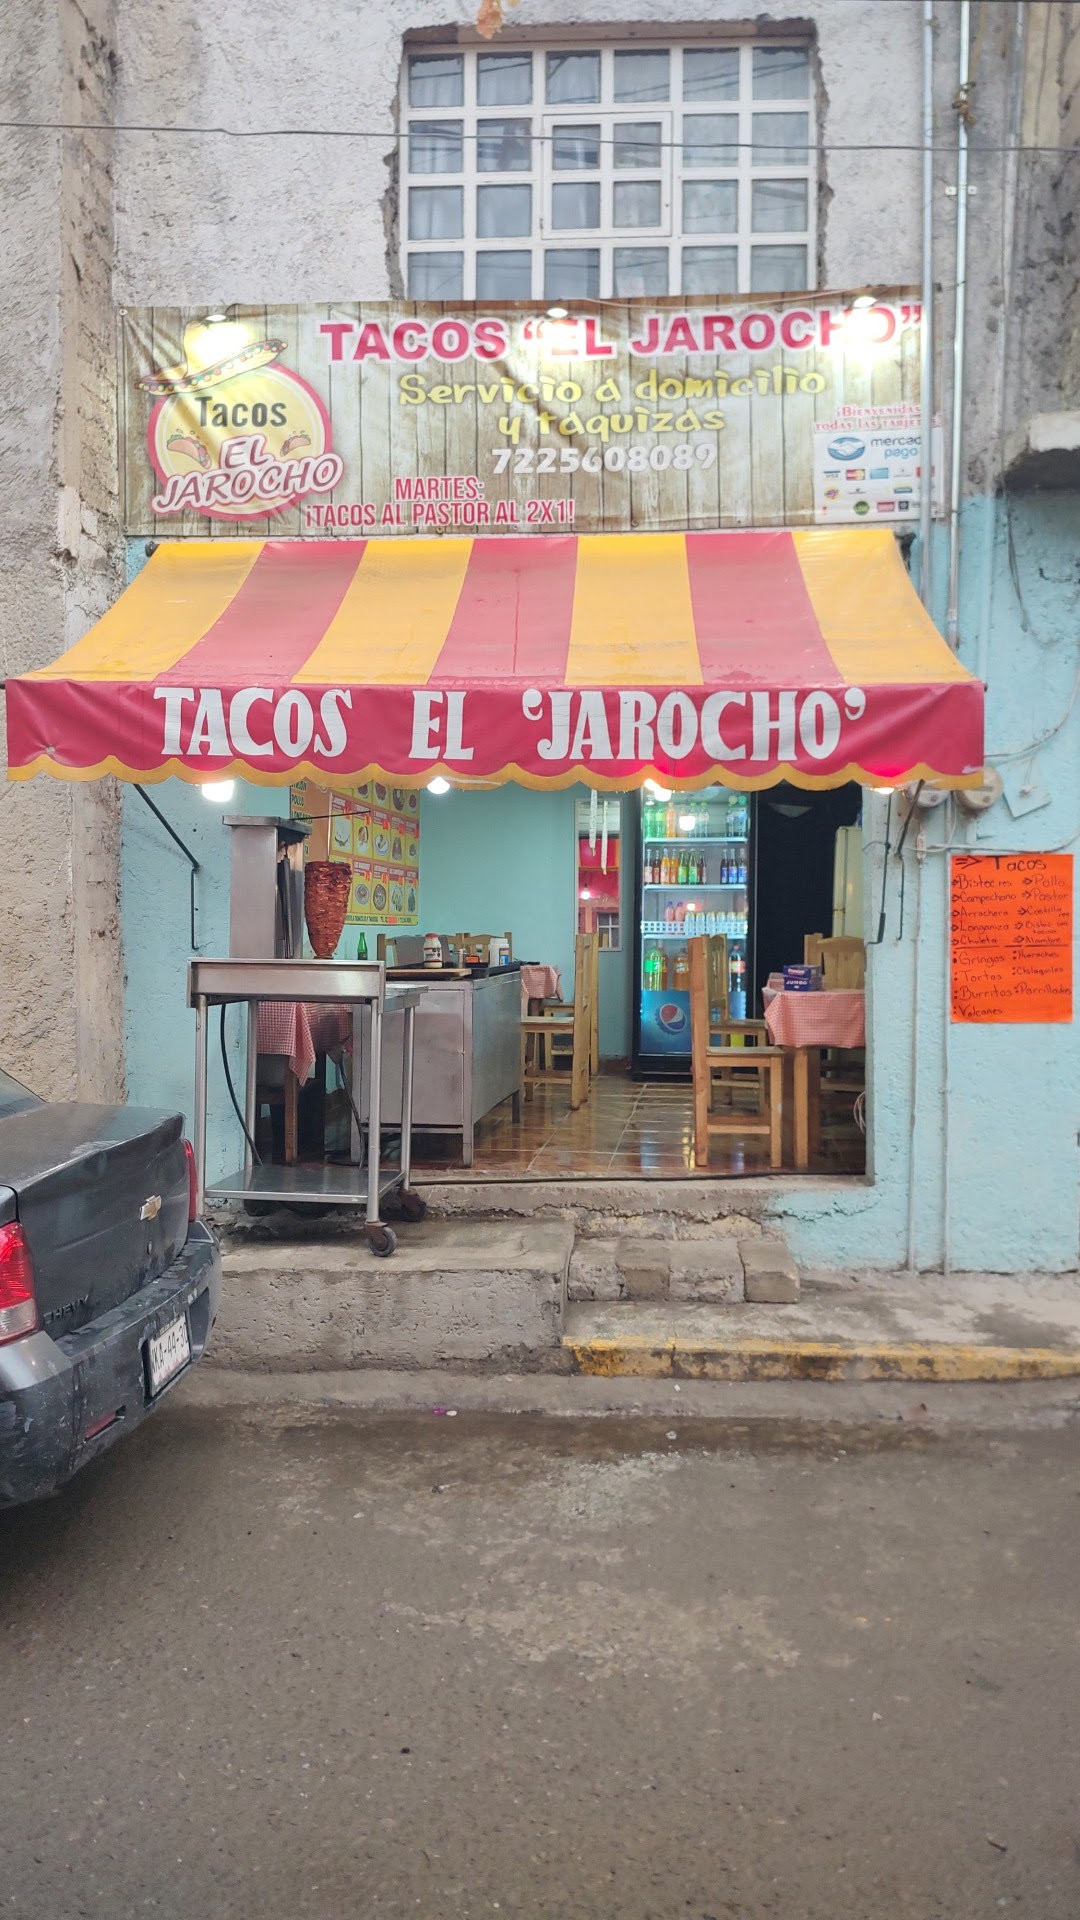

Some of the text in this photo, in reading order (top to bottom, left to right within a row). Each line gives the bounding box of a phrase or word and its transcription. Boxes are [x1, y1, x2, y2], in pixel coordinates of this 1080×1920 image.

[320, 321, 508, 361] TACOS
[400, 366, 827, 404] Servicio a domicilio
[195, 396, 287, 428] Tacos
[499, 406, 726, 444] y taquizas
[224, 438, 269, 469] EL
[491, 443, 718, 475] 7225608089
[884, 447, 918, 460] pago
[156, 457, 339, 510] JAROCHO
[395, 476, 484, 500] MARTES:
[306, 499, 576, 527] ¡TACOS AL PASTOR AL 2X1!
[153, 686, 353, 758] TACOS
[408, 689, 475, 760] EL
[985, 855, 1047, 872] Tacos
[1032, 874, 1066, 888] Pollo
[959, 891, 1017, 904] Campechano
[1031, 888, 1069, 901] Pastor
[960, 906, 1009, 918] Arrachera
[960, 921, 1009, 935] Longaniza
[960, 935, 997, 945] Chuleta
[959, 970, 1002, 982] Tortas
[959, 983, 1013, 1001] Burritos
[958, 1004, 1003, 1018] Volcanes
